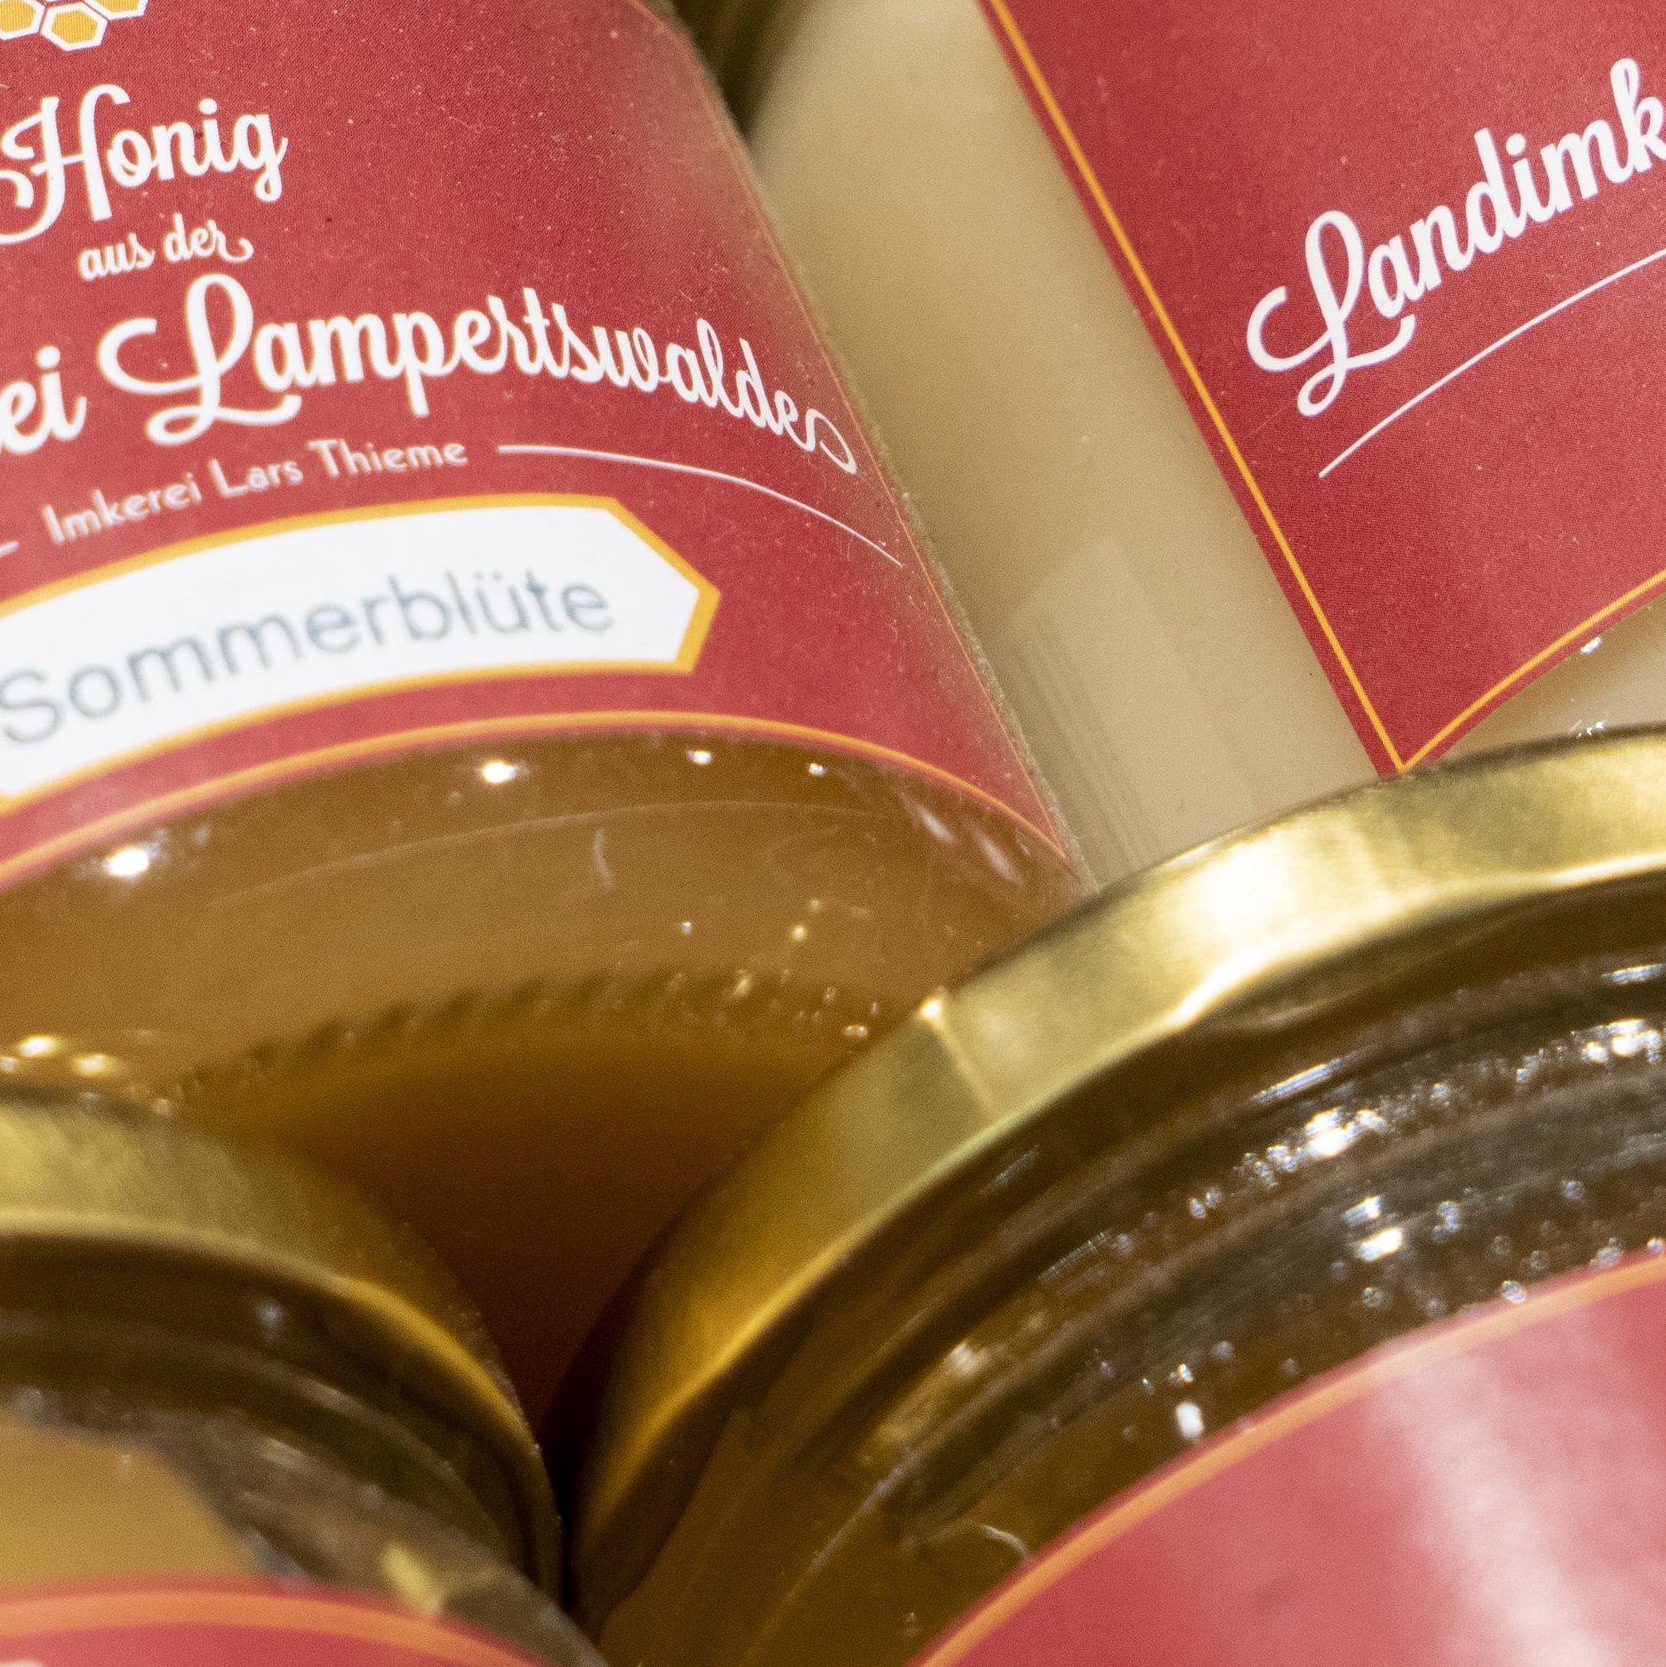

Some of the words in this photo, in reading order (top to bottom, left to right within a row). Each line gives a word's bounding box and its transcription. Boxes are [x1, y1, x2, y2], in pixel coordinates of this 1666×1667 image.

[77, 227, 156, 282] aus
[162, 212, 254, 269] der
[98, 273, 861, 476] Lampertswalde
[43, 470, 202, 547] Imkerei
[211, 446, 305, 503] Lars
[316, 432, 468, 477] Thieme
